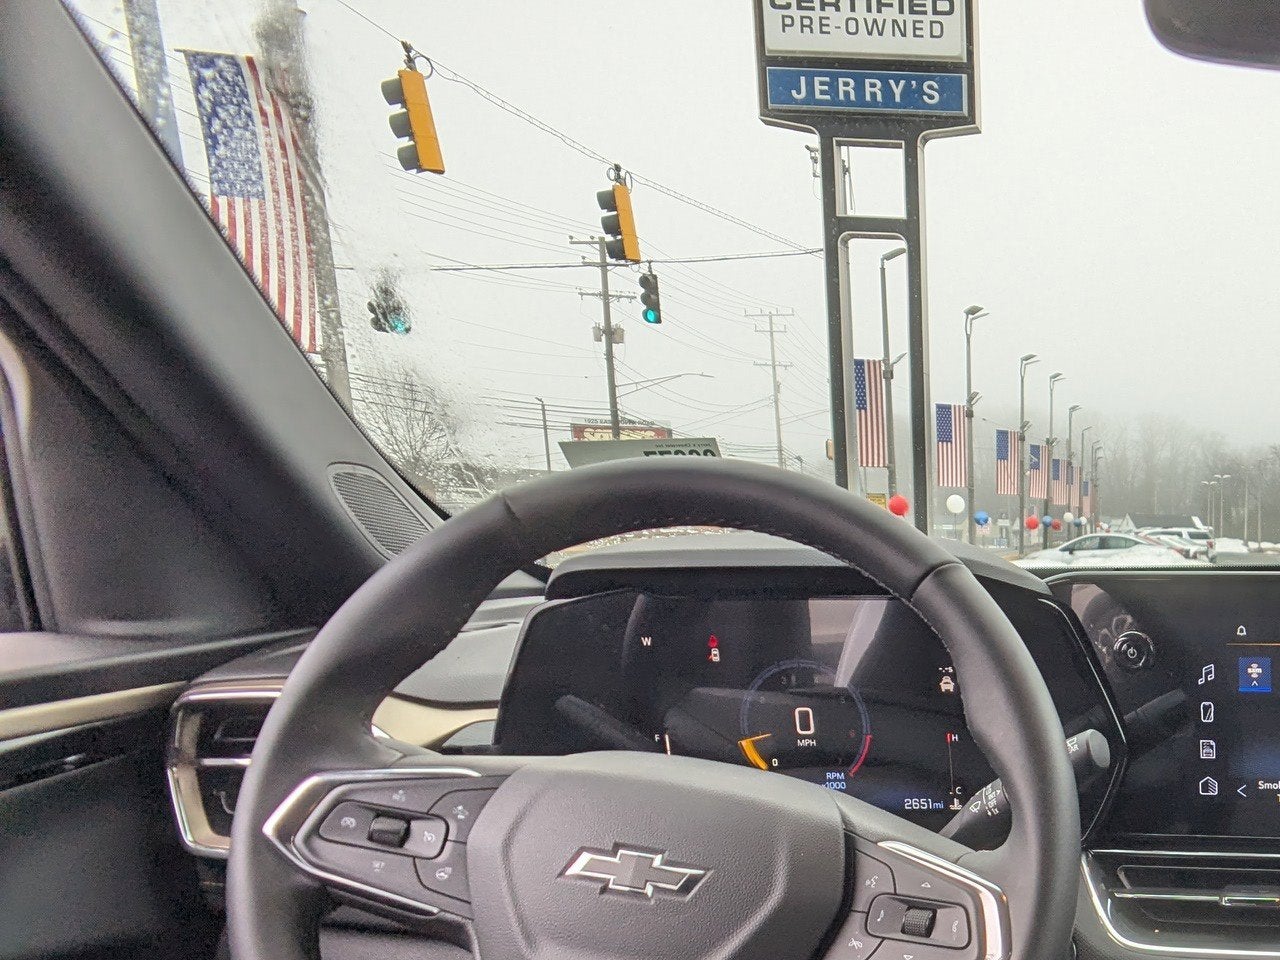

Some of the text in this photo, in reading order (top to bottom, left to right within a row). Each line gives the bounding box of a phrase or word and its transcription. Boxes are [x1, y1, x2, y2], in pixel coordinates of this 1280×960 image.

[781, 14, 944, 38] PRE-OWNED
[791, 76, 940, 104] JERRY'S
[641, 636, 652, 646] W
[794, 706, 814, 734] 0
[772, 758, 778, 766] 0
[904, 798, 932, 809] 2651
